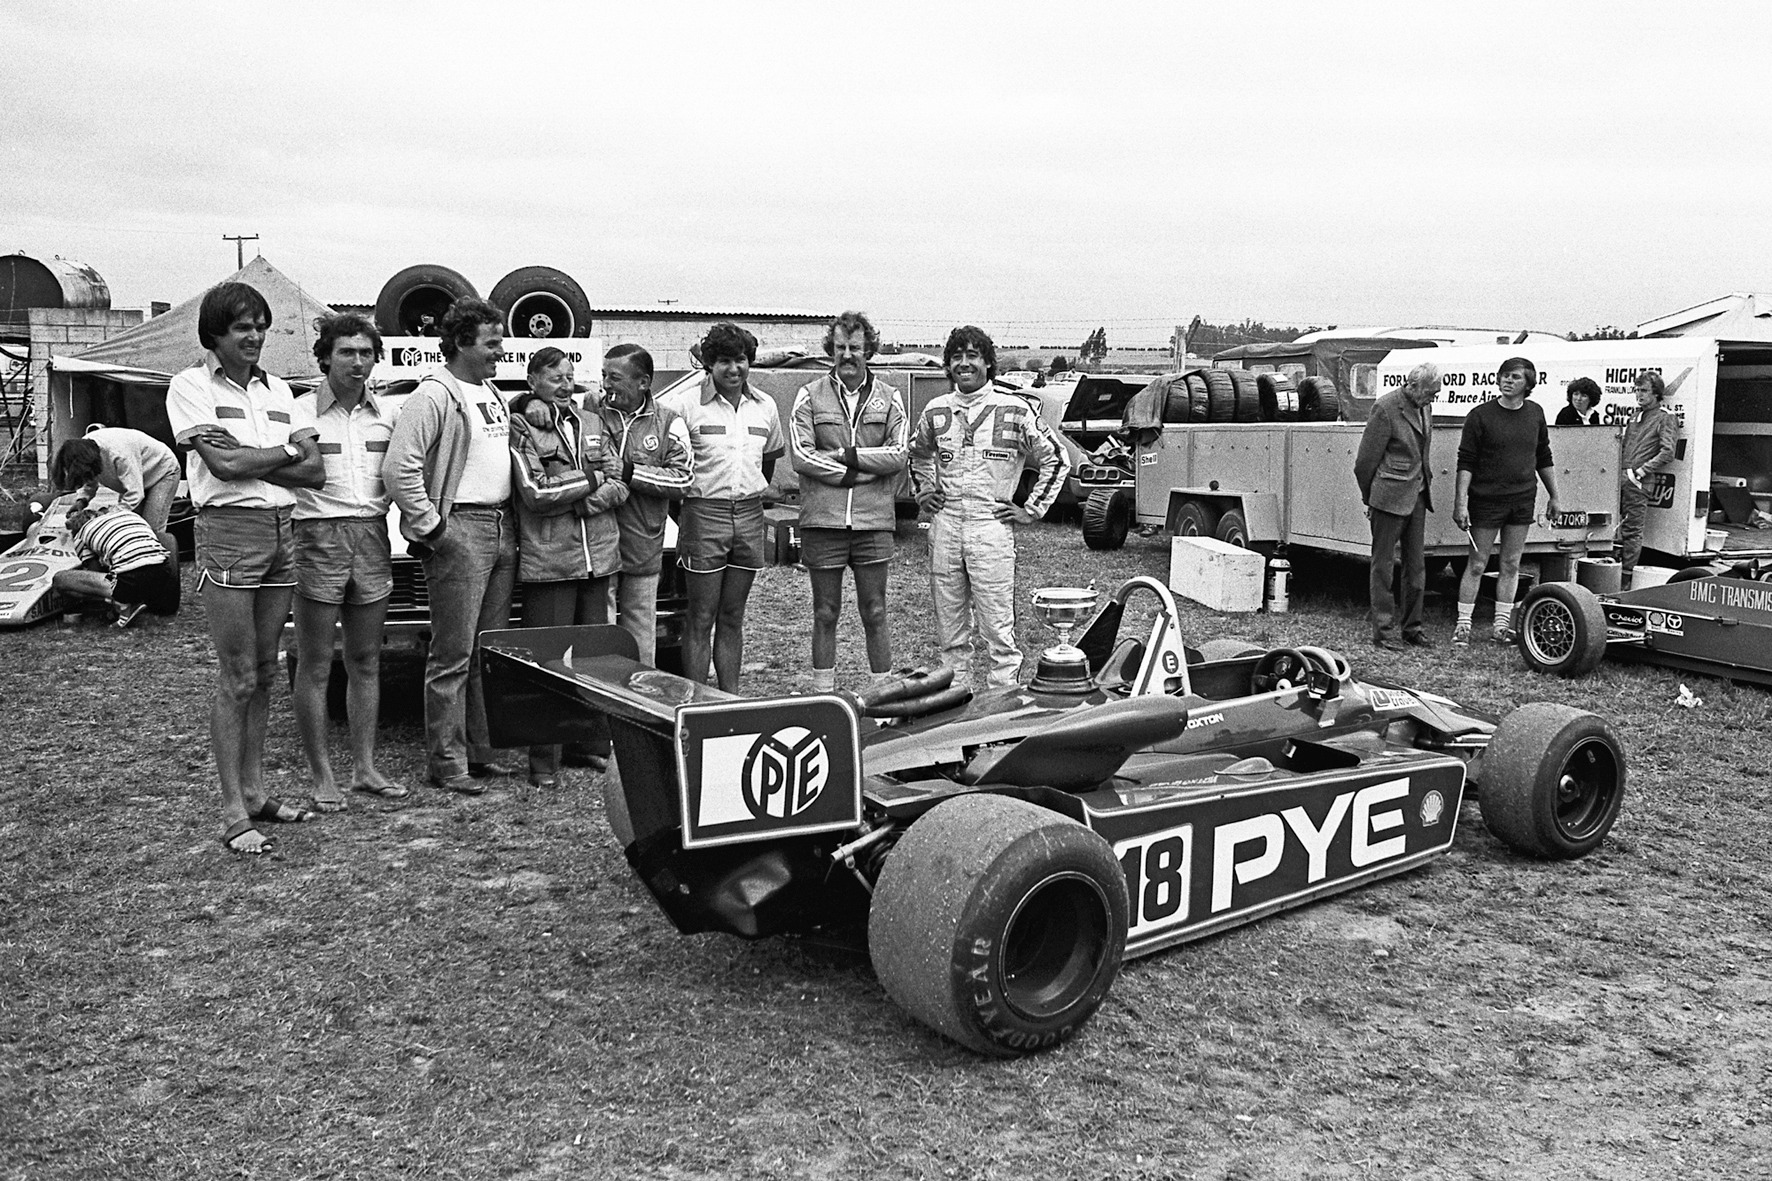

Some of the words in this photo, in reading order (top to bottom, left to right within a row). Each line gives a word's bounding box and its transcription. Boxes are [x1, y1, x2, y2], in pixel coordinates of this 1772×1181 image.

[424, 351, 442, 363] THE
[516, 352, 526, 363] IN
[925, 404, 1029, 449] PYE
[1141, 454, 1157, 465] Shell
[0, 562, 49, 593] 2
[1690, 580, 1717, 603] BMC
[751, 727, 830, 818] PYE
[1211, 776, 1410, 914] PYE
[1118, 835, 1184, 929] 18
